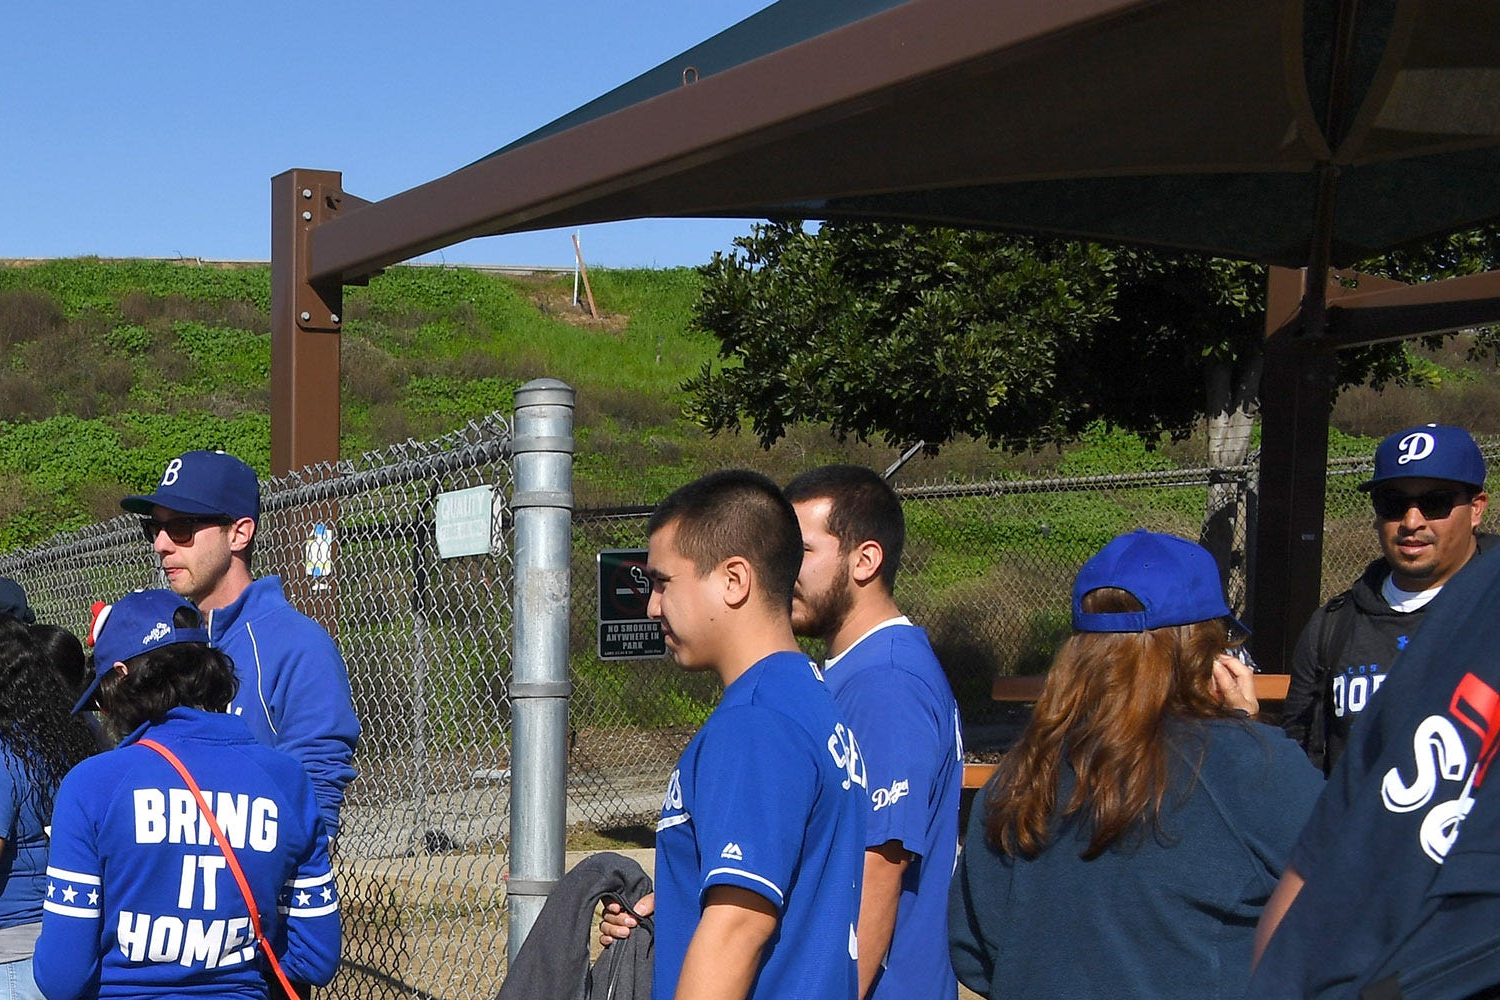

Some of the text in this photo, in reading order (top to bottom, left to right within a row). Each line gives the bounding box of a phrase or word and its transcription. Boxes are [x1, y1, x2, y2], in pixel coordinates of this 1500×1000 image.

[1398, 432, 1435, 465] D
[160, 458, 183, 487] B
[606, 632, 660, 642] ANYWHERE IN
[607, 623, 658, 633] NO SMOKING
[622, 641, 643, 650] PARK
[133, 788, 279, 853] BRING
[178, 854, 227, 911] IT
[117, 910, 256, 970] HOME!
